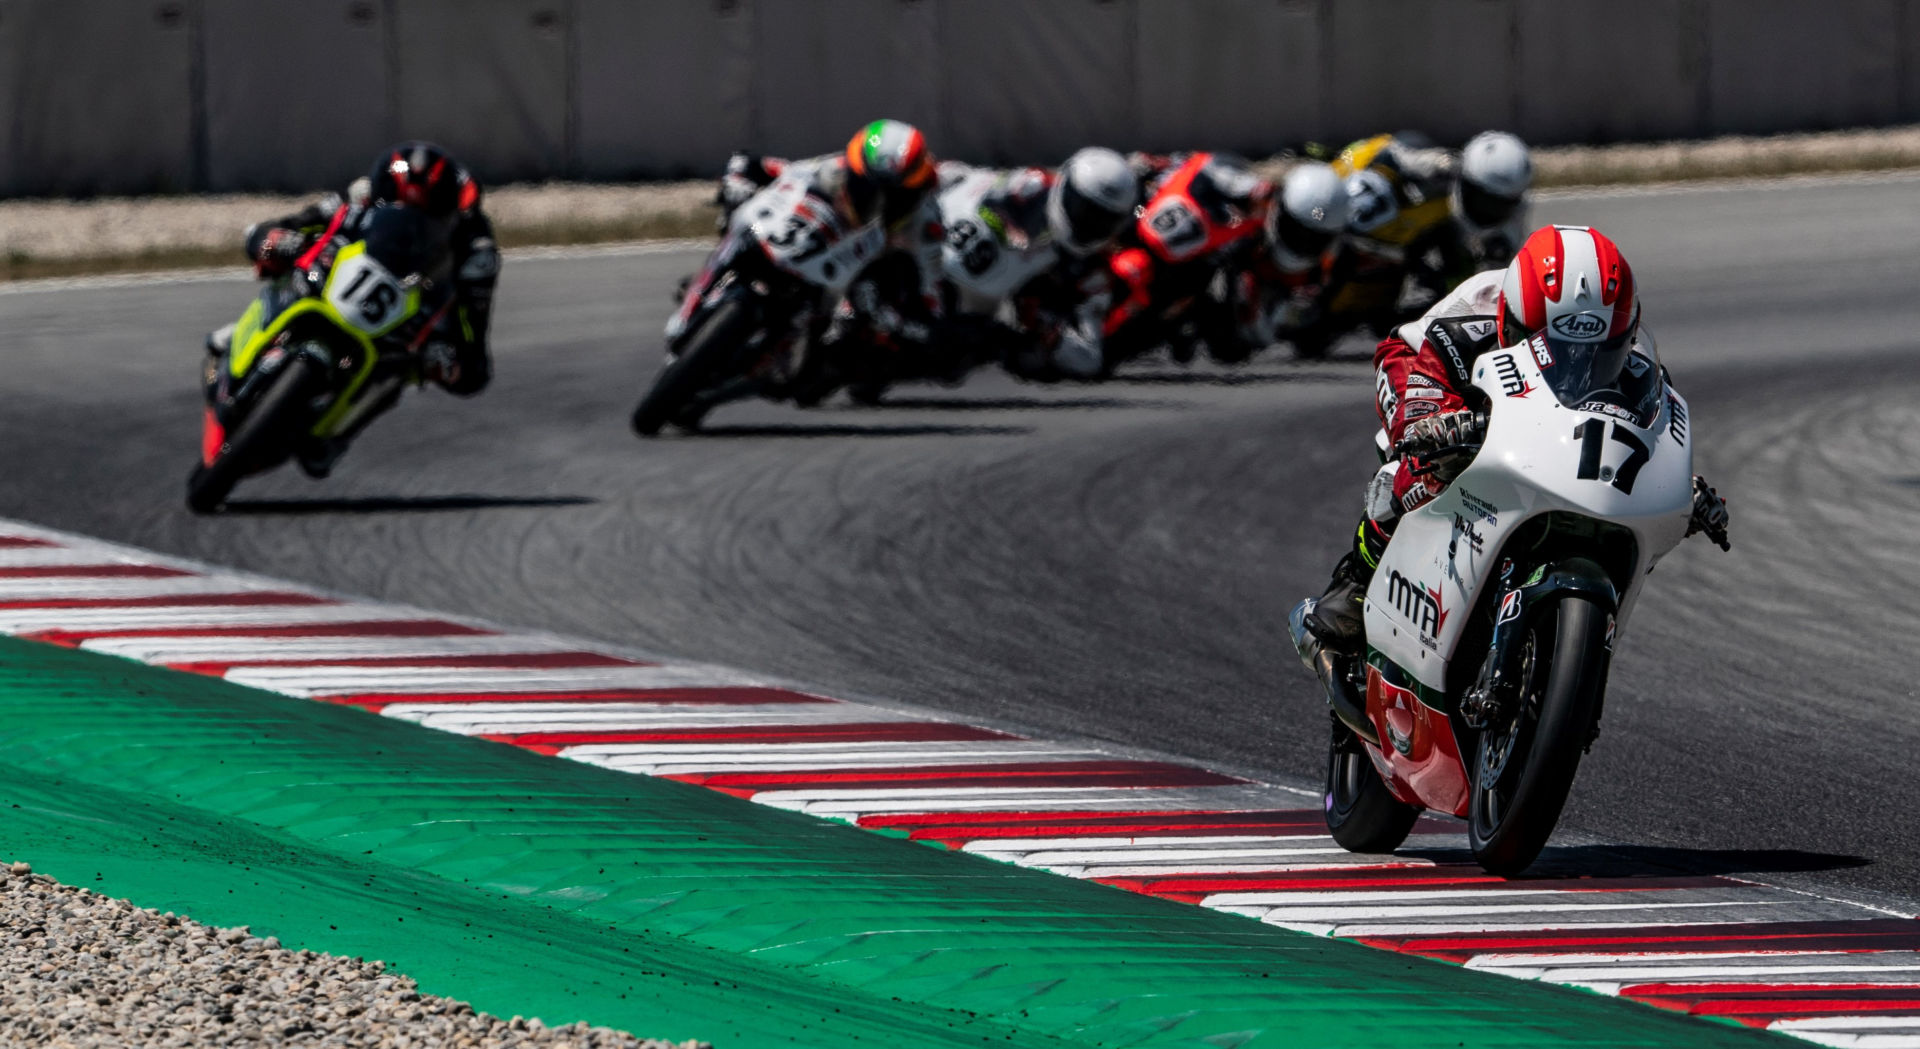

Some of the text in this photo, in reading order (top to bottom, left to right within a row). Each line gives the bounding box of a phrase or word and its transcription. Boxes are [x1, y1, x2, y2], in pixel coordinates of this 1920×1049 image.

[340, 266, 399, 325] 16
[1558, 315, 1601, 332] Arai
[1432, 324, 1469, 380] VIRCOS
[1493, 353, 1526, 398] MTA
[1573, 417, 1650, 496] 17
[1402, 482, 1428, 512] MTA
[1388, 569, 1440, 640] MTA
